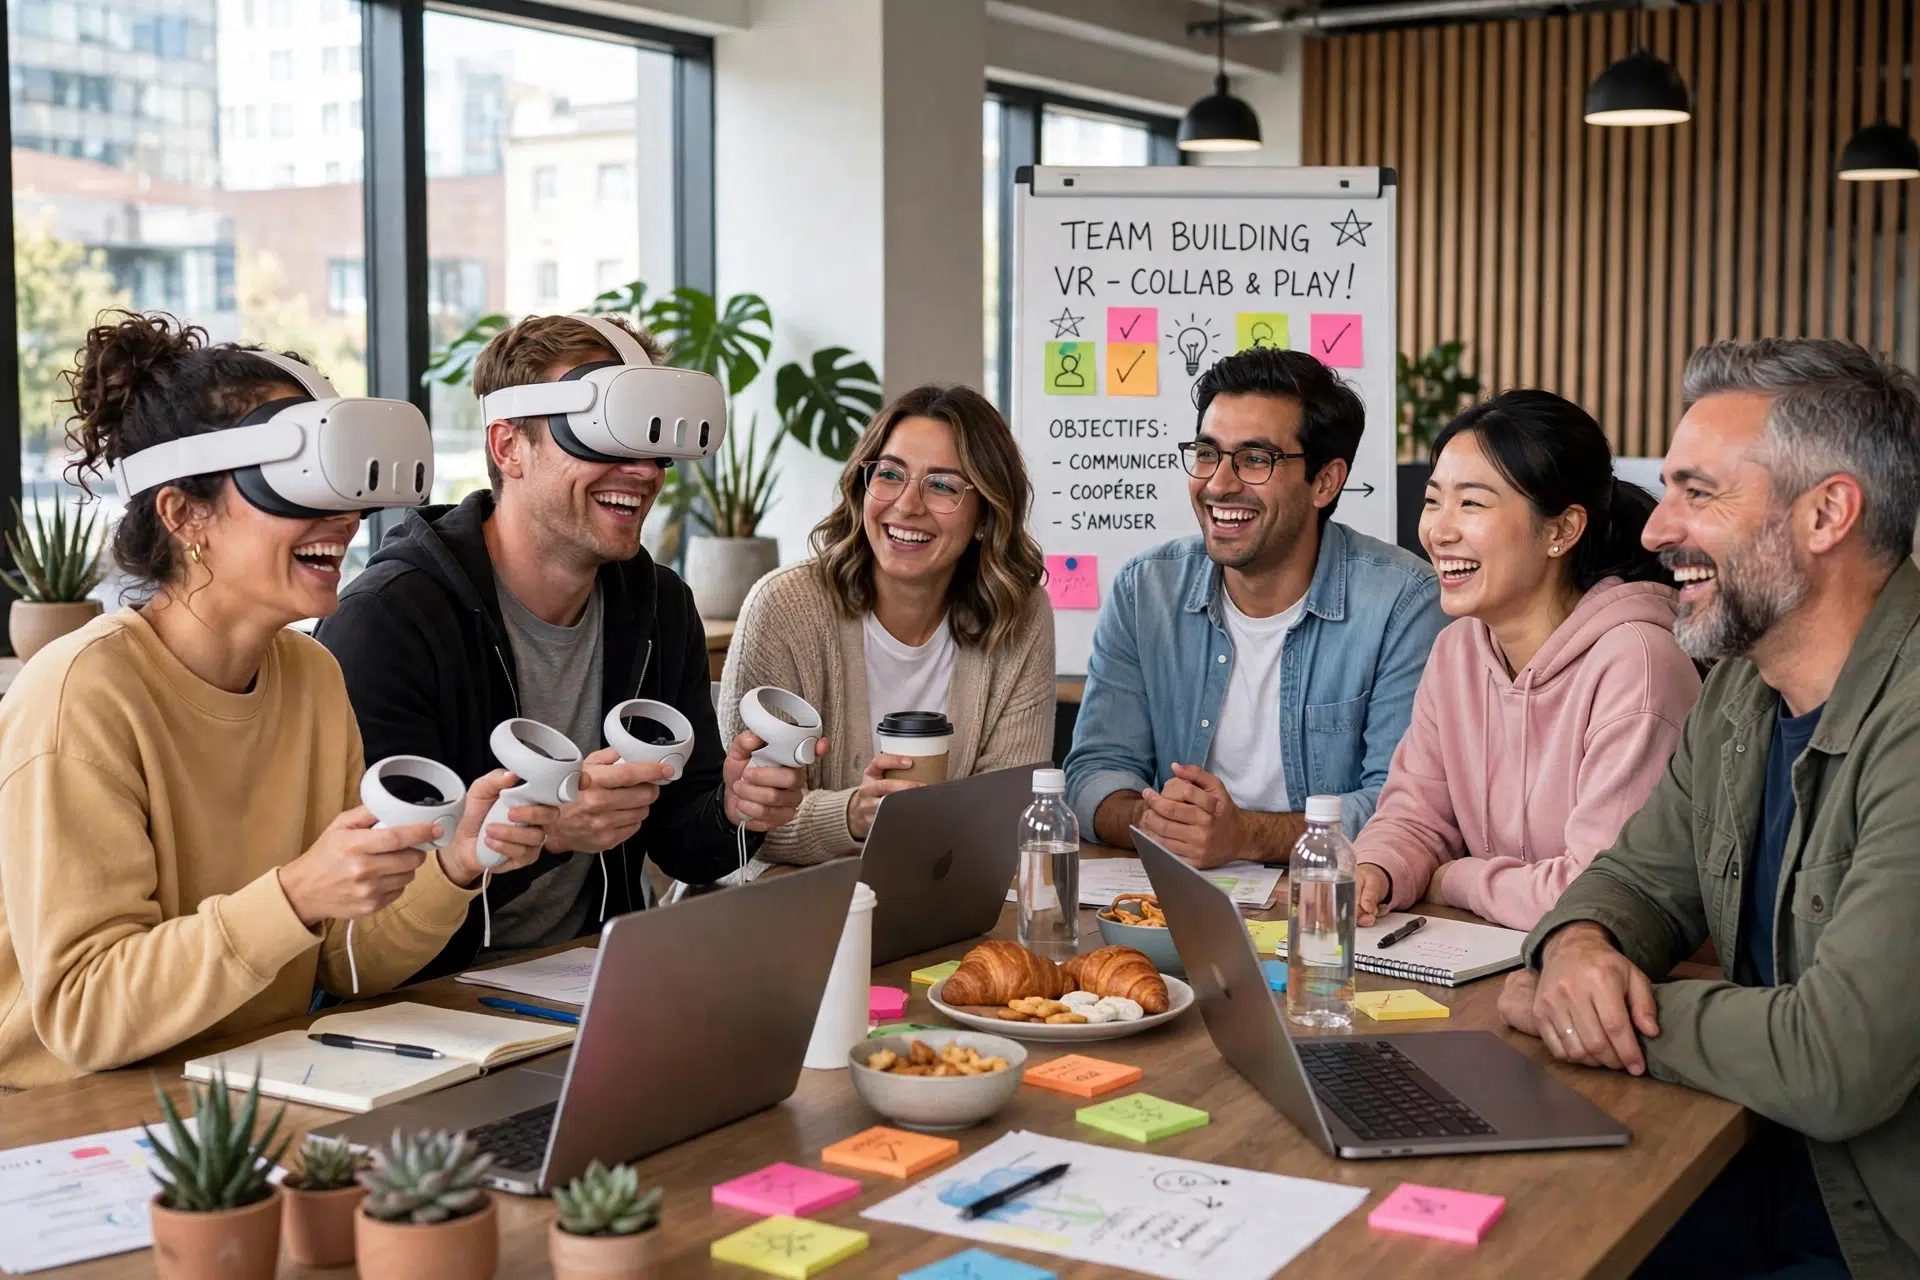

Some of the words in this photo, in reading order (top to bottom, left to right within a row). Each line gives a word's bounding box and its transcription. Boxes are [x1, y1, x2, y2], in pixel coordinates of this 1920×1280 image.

[1060, 220, 1153, 252] TEAM
[1171, 221, 1310, 254] BUILDING
[1054, 265, 1096, 297] VR
[1130, 268, 1234, 297] COLLAB
[1245, 272, 1261, 295] &
[1274, 262, 1355, 300] PLAY!
[1049, 418, 1168, 439] OBJECTIFS:
[1069, 453, 1180, 470] COMMUNICER
[1070, 480, 1158, 501] COOPÉRER
[1071, 511, 1157, 531] S'AMUSER
